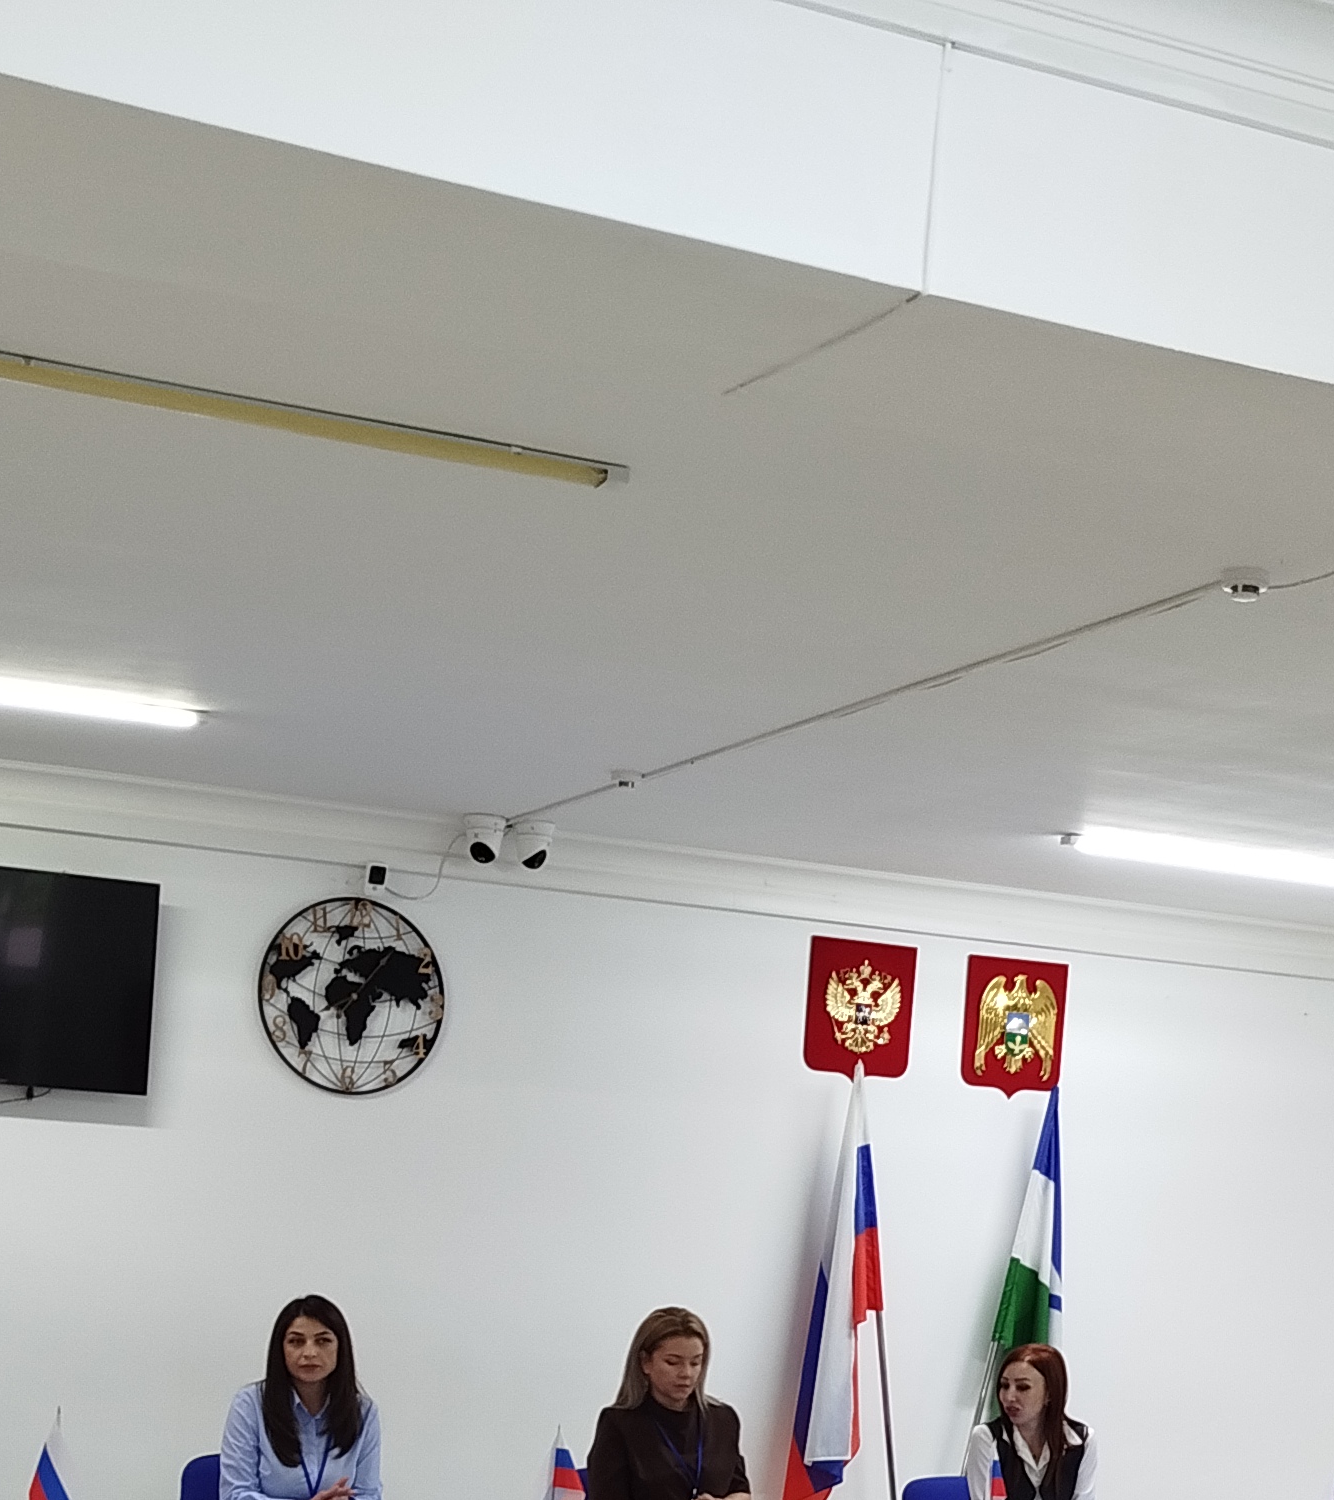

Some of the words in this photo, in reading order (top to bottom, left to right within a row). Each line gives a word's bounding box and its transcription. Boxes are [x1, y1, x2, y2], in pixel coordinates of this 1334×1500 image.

[278, 932, 304, 961] 10
[418, 948, 433, 975] 2
[272, 1015, 287, 1042] 8
[412, 1032, 427, 1058] 4
